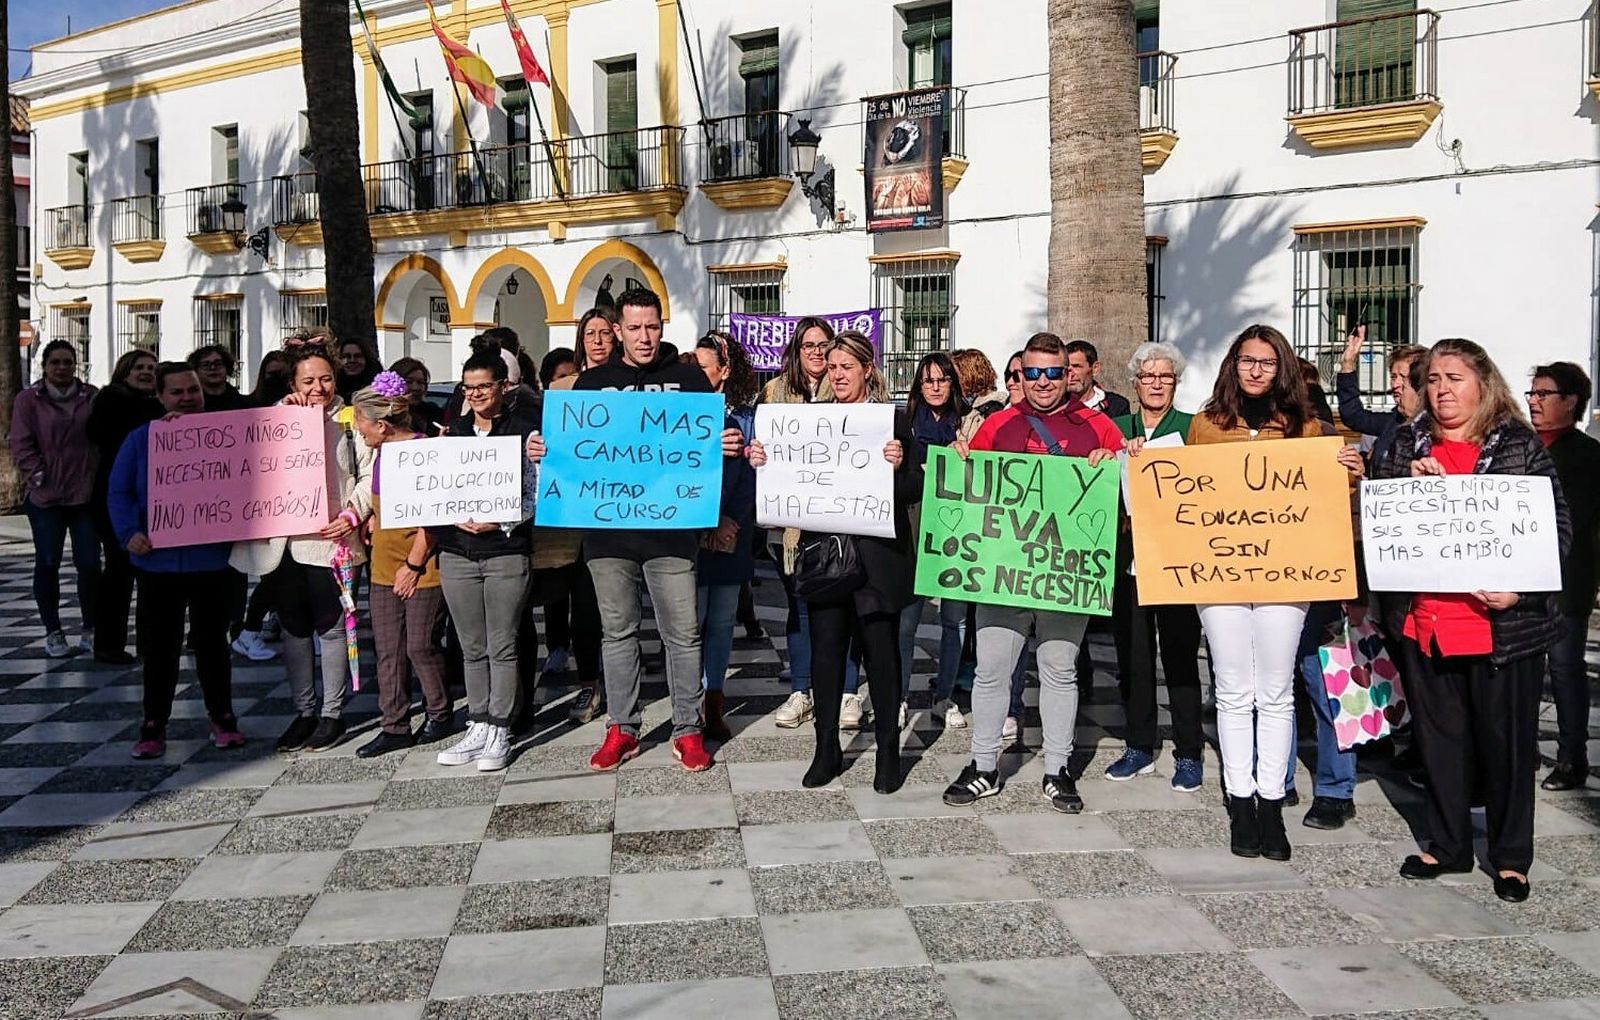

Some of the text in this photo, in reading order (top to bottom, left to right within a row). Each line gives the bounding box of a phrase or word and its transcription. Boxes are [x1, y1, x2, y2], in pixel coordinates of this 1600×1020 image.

[892, 97, 906, 118] NO
[733, 318, 849, 347] TREBUNA
[245, 419, 303, 444] NIÑ@S
[562, 401, 714, 441] NO MAS
[772, 414, 860, 438] NO AL
[241, 459, 251, 474] A
[260, 456, 278, 472] SU
[285, 448, 325, 469] SEÑOS
[398, 448, 497, 468] POR UNA
[416, 471, 514, 491] EDUCACION
[544, 479, 561, 499] A
[676, 484, 703, 499] DE
[796, 470, 834, 486] DE
[935, 454, 1104, 516] LUISA Y
[1365, 480, 1447, 498] NUESTROS
[394, 496, 521, 519] SIN TRASTORNO
[594, 502, 677, 522] CURSO
[764, 494, 891, 521] MAESTRA
[1517, 500, 1530, 514] A
[982, 505, 1063, 547] EVA
[1417, 518, 1495, 536] SEÑOS
[1512, 519, 1538, 536] NO
[924, 532, 981, 562] LOS
[1208, 536, 1271, 557] SIN
[1379, 544, 1424, 563] MAS
[938, 566, 986, 593] OS
[1163, 562, 1347, 587] TRASTORNOS
